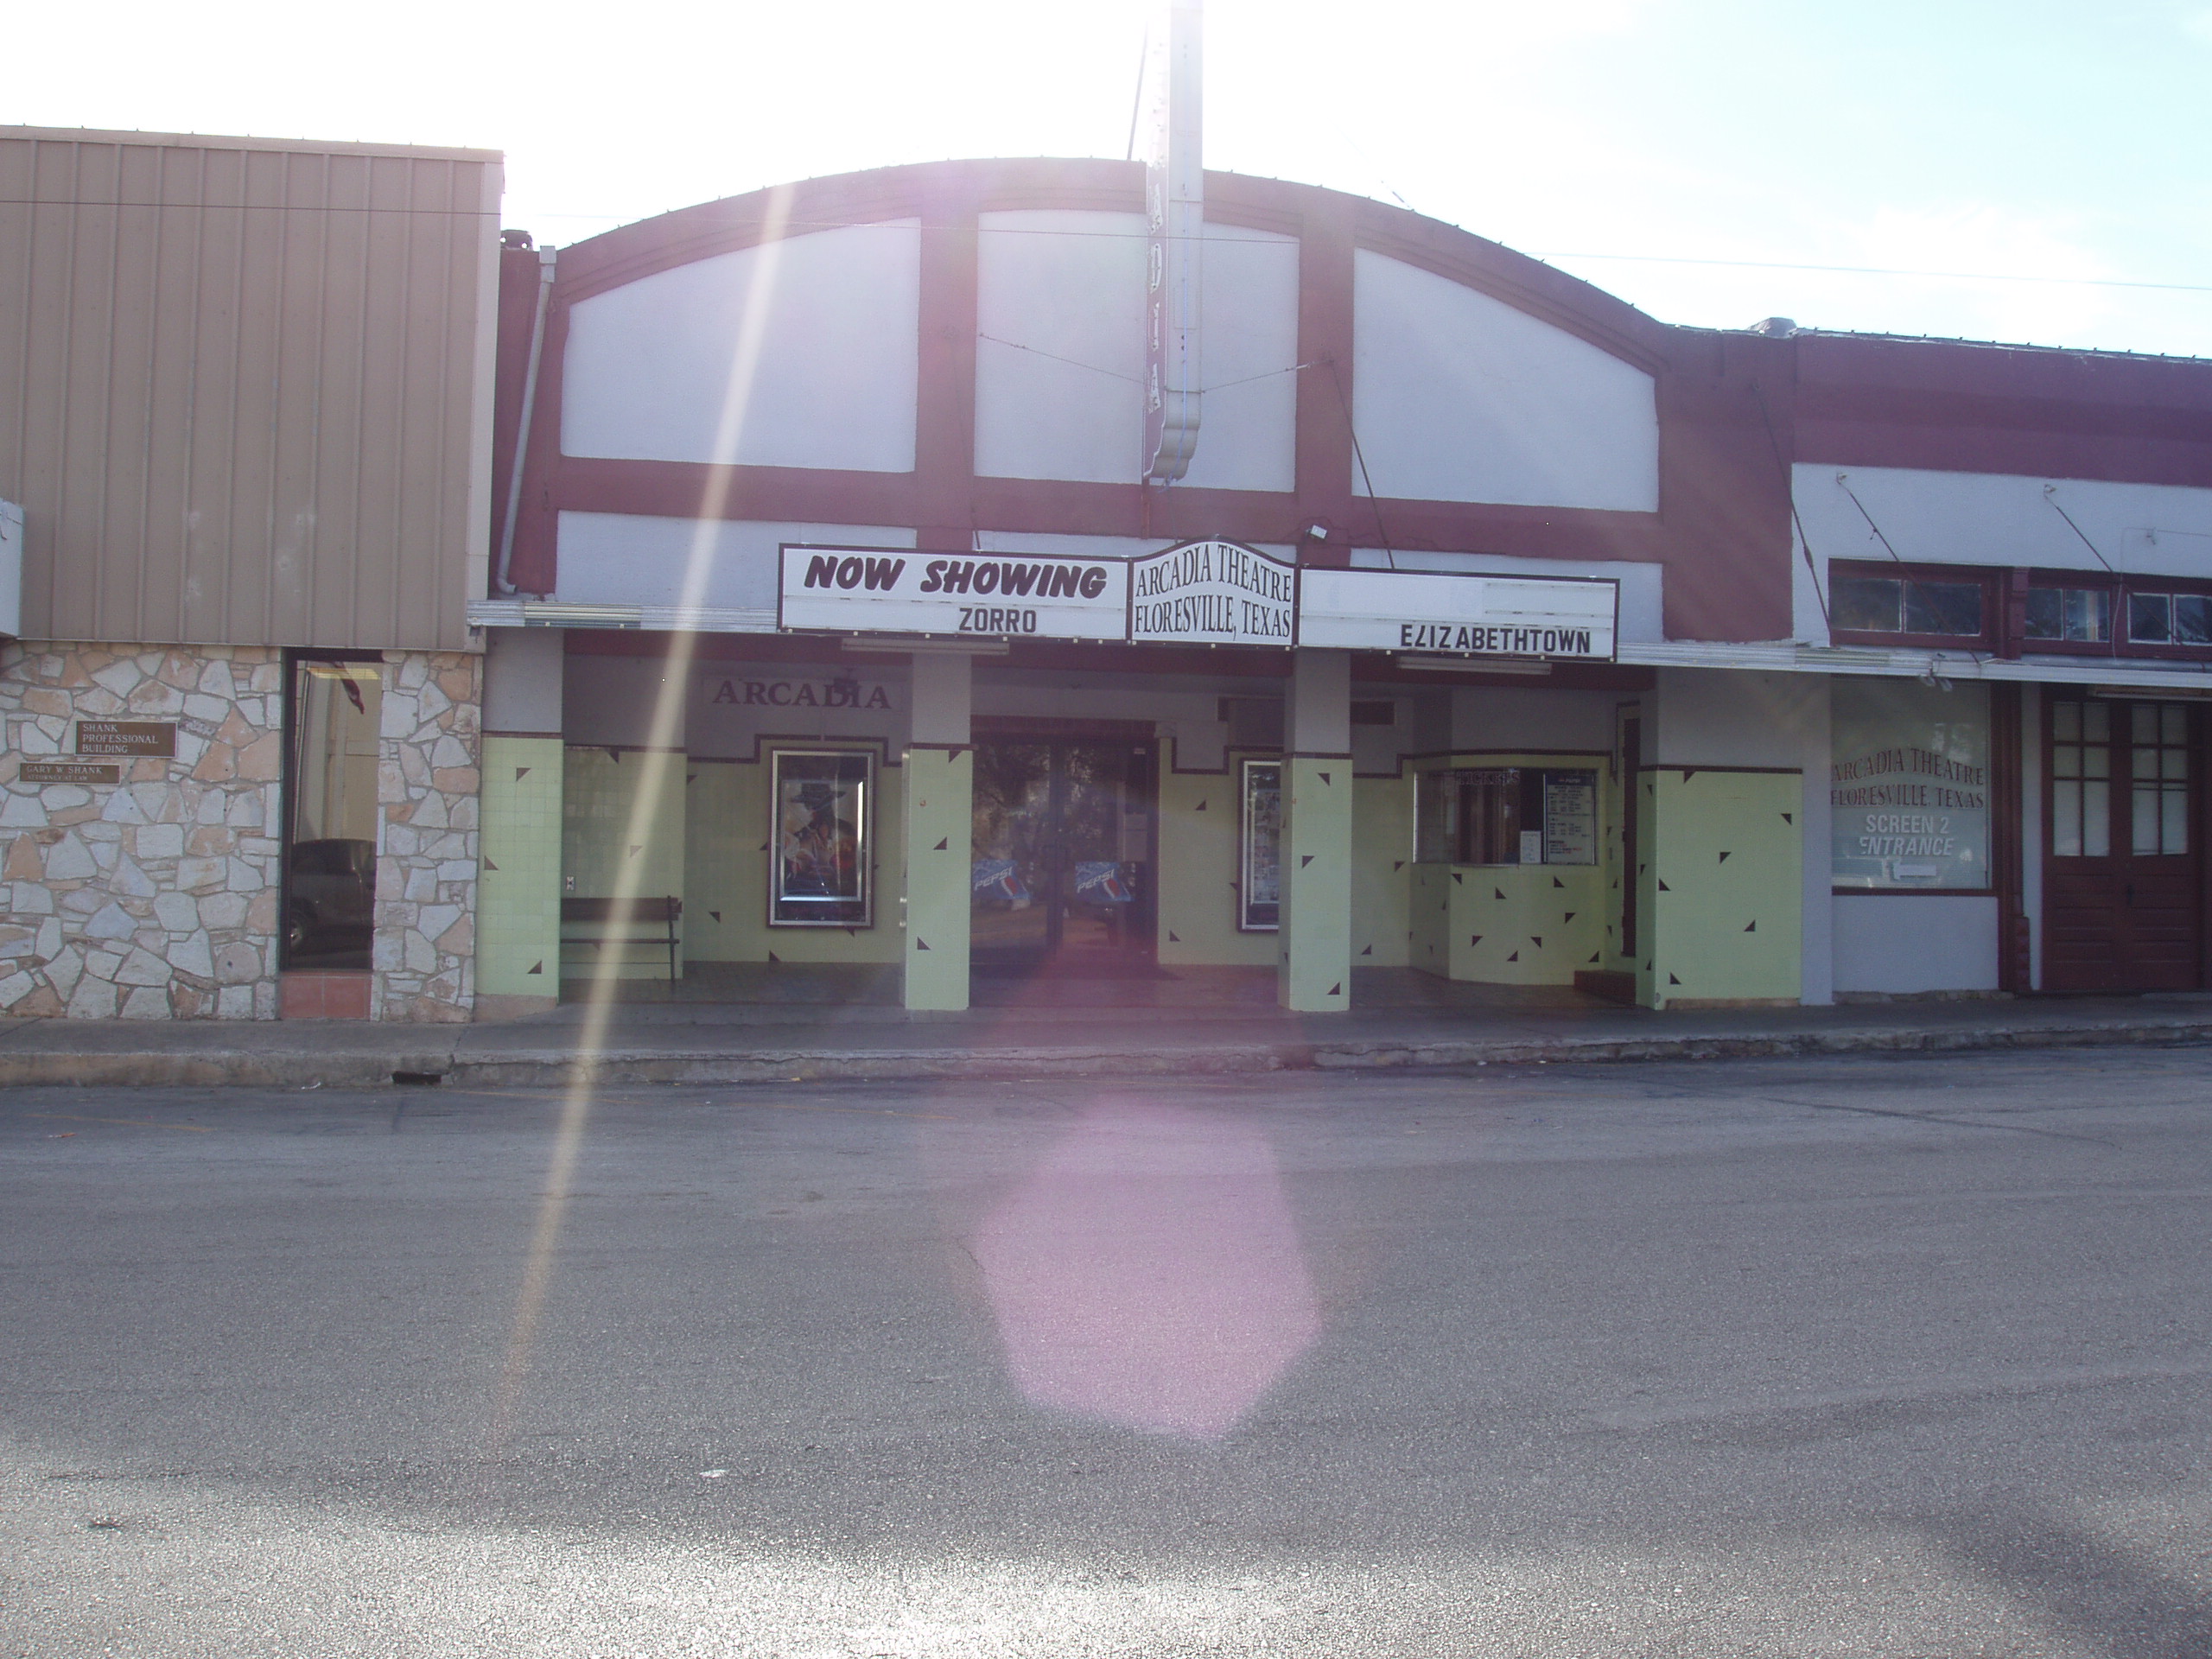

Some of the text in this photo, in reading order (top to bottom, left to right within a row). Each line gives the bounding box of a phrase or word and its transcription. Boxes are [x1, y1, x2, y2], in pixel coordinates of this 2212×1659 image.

[804, 555, 1108, 600] NOW SHOWING
[1135, 544, 1292, 604] ARCADIA THEATRE
[958, 607, 1037, 633] ZORRO
[1134, 594, 1291, 642] FLORESVILLE, TEXAS
[1400, 624, 1592, 654] ELIZABETHTOWN
[712, 679, 893, 709] ARCADIA
[82, 724, 118, 733] SHANK
[82, 734, 159, 744] PROFESSIONAL
[82, 744, 129, 753] BUILDING
[68, 766, 104, 775] SHANK
[1831, 747, 1984, 785] ARCADIA THEATRE
[1935, 786, 1984, 810] TEXAS
[1866, 814, 1950, 835] SCREEN 2
[974, 866, 1014, 892] PEPSI
[1077, 868, 1116, 893] PEPSI
